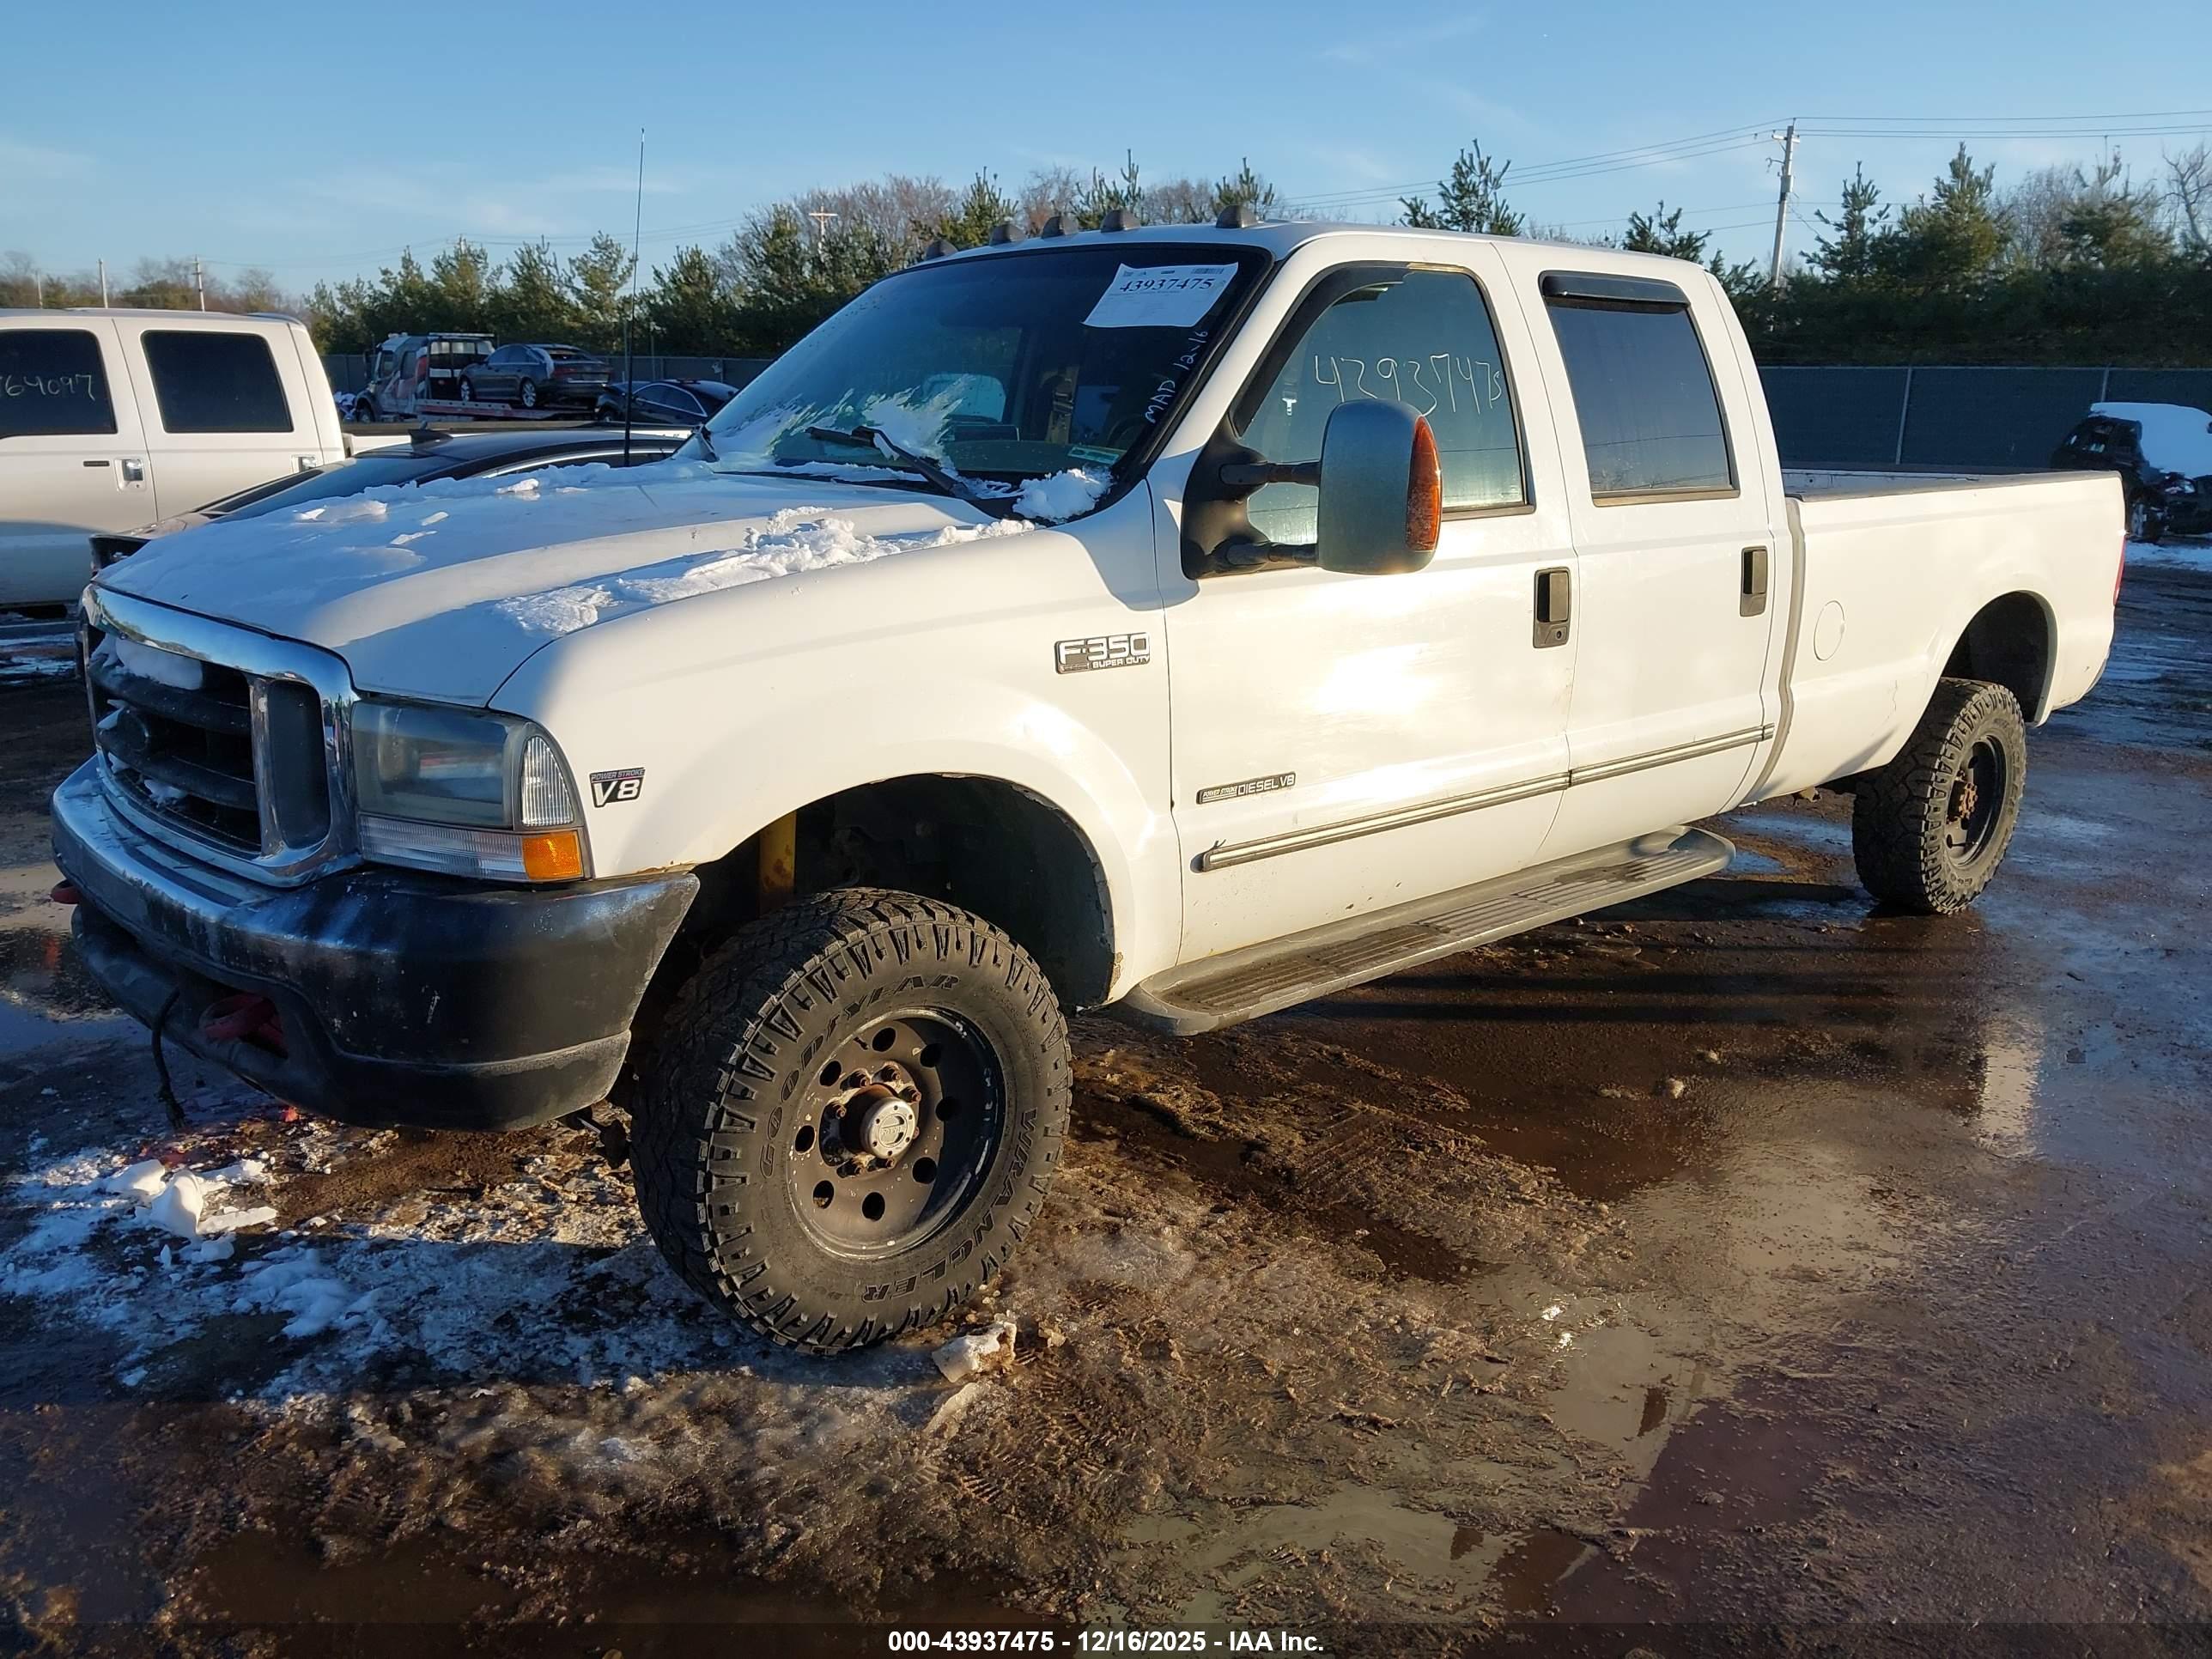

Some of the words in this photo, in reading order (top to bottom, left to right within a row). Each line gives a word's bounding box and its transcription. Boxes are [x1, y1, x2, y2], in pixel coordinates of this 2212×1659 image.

[1119, 278, 1216, 292] 43937475
[1145, 380, 1176, 423] MAD
[1092, 658, 1123, 669] SUPER
[1126, 655, 1150, 665] DUTY
[591, 772, 617, 781] POWER
[617, 769, 644, 778] STROKE
[1237, 778, 1279, 796] DIESEL
[1279, 774, 1295, 787] V8
[592, 779, 641, 806] V8
[759, 975, 960, 1179] GOODYEAR
[861, 1107, 1038, 1303] WRANGLER
